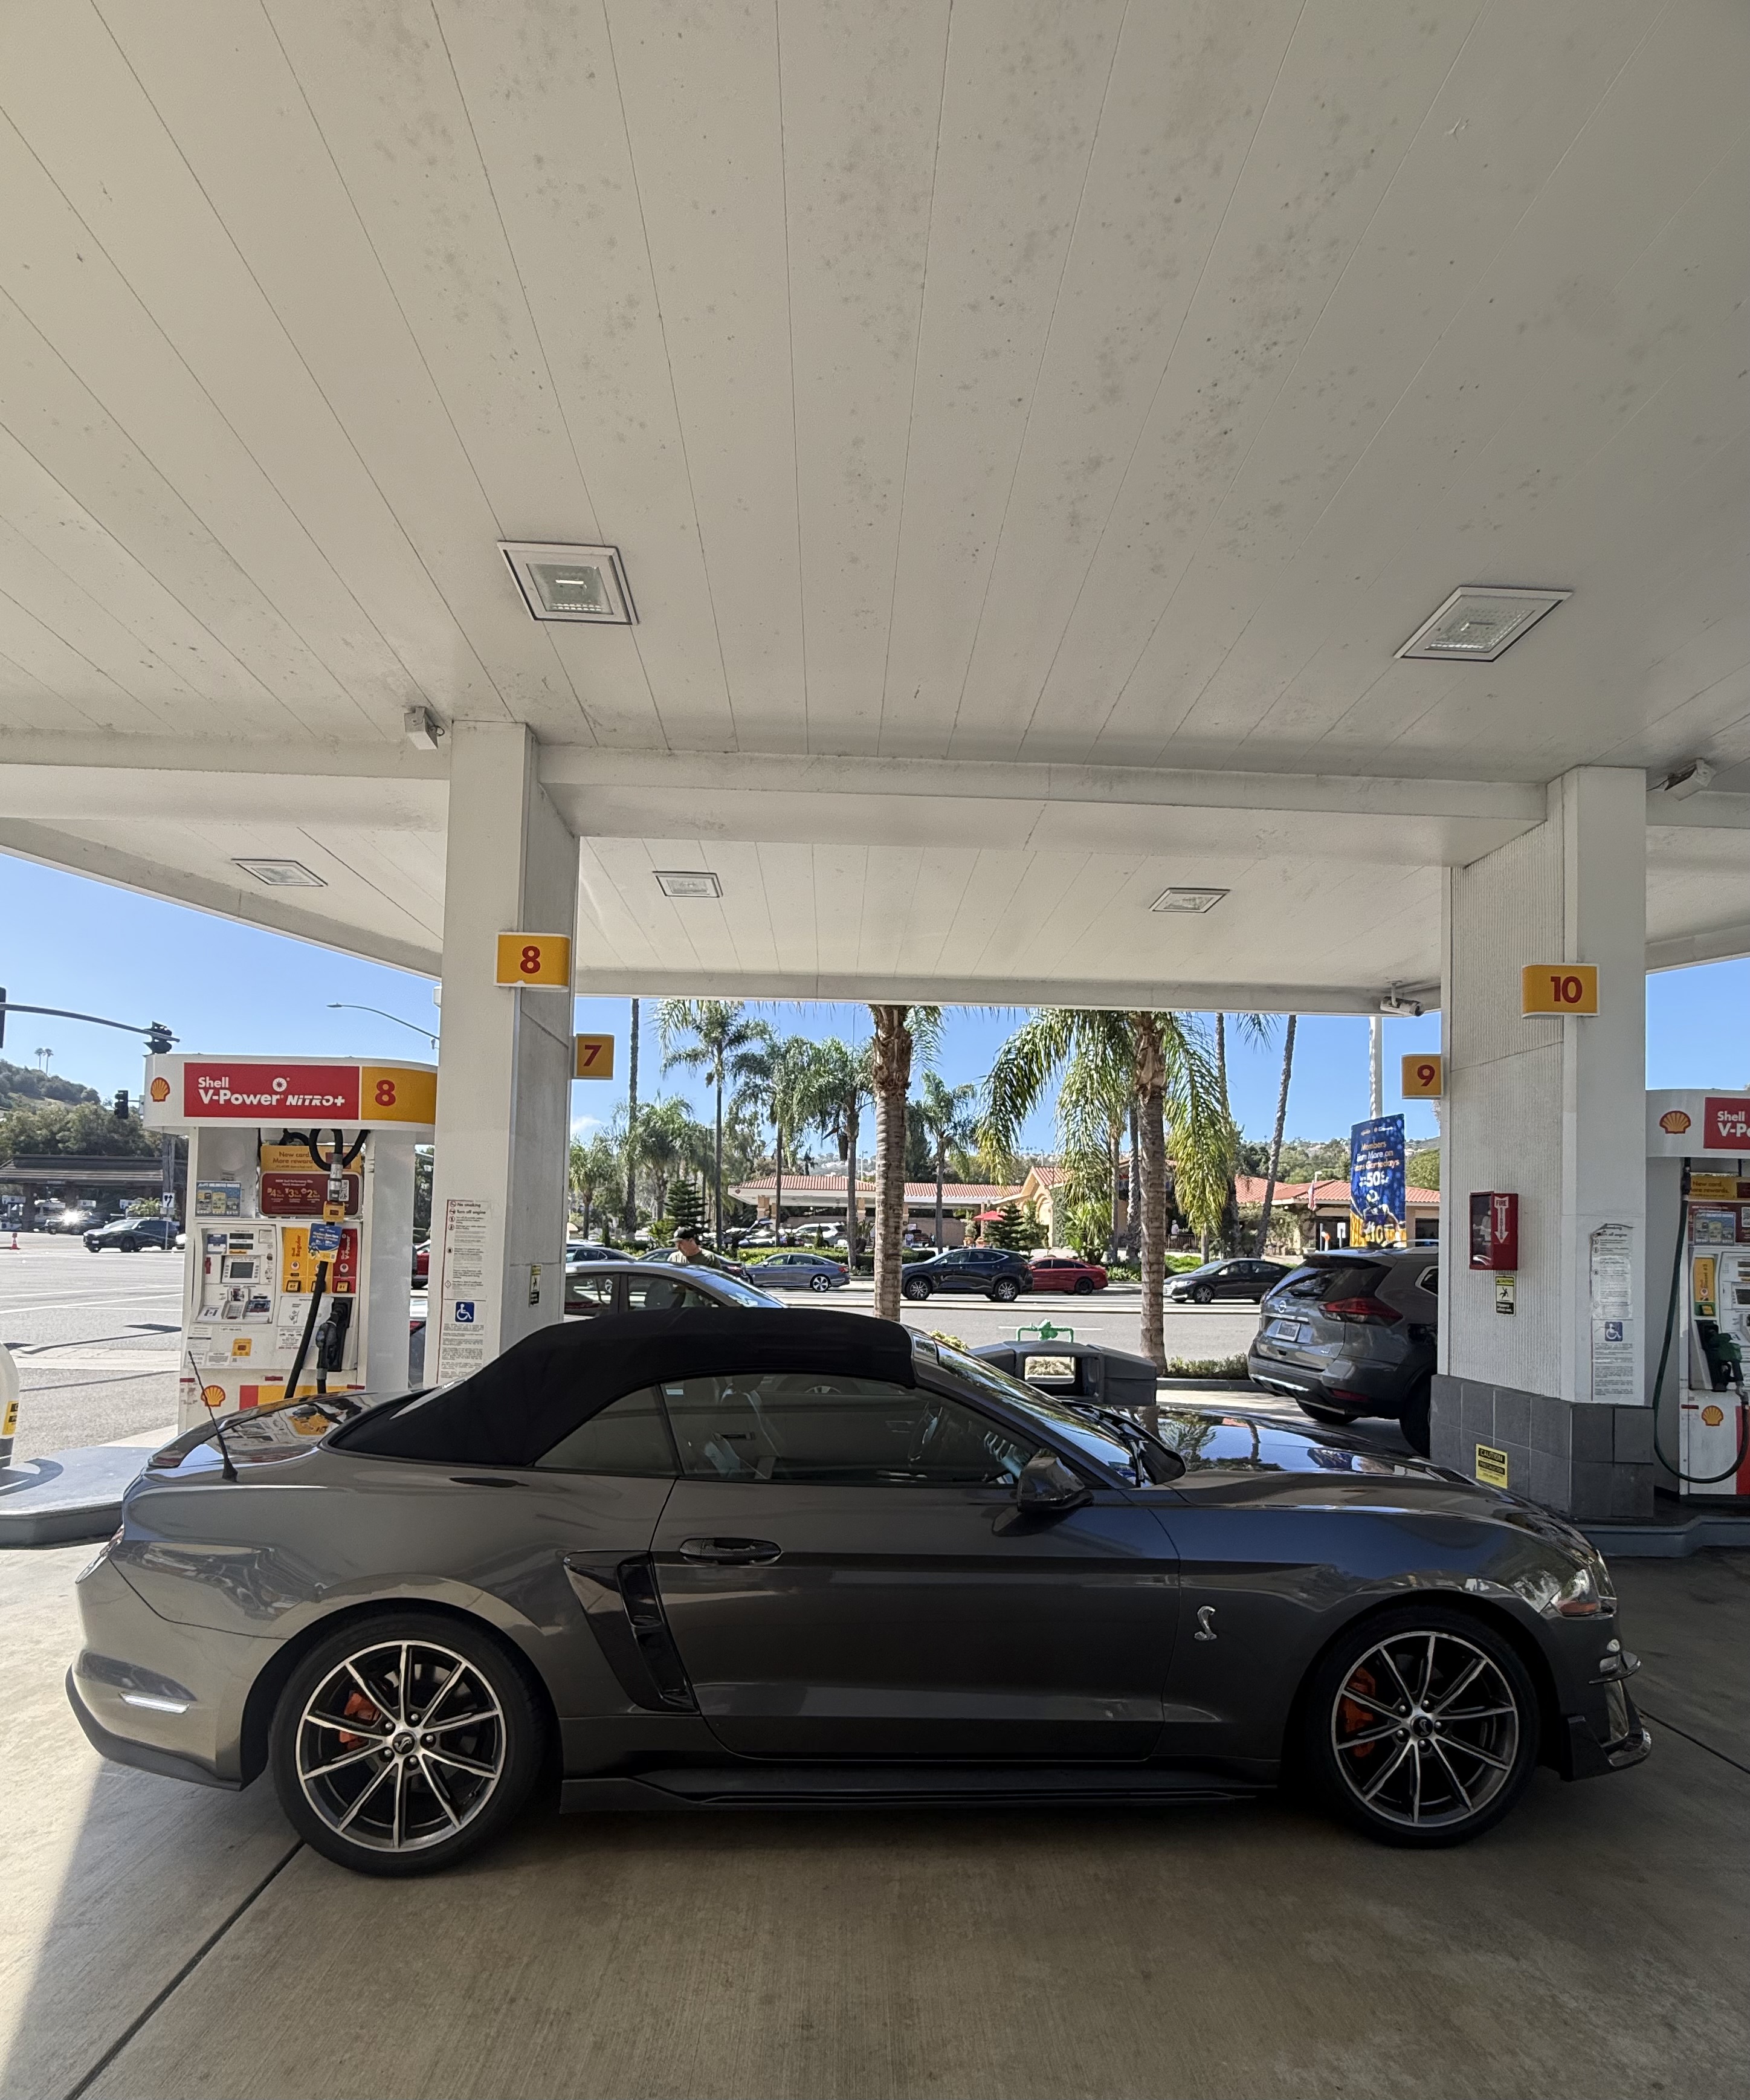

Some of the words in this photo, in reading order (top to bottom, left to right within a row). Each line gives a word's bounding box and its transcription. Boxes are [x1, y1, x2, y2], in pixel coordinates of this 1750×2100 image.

[520, 945, 541, 974] 8
[1550, 975, 1583, 1004] 10
[583, 1044, 602, 1067] 7
[198, 1076, 229, 1088] Shell
[1417, 1064, 1435, 1087] 9
[198, 1088, 281, 1105] V-Power
[375, 1079, 396, 1107] 8
[1717, 1110, 1746, 1122] Shell
[1361, 1141, 1387, 1151] Members
[1367, 1151, 1384, 1160] More
[1480, 1449, 1503, 1462] CAUTION
